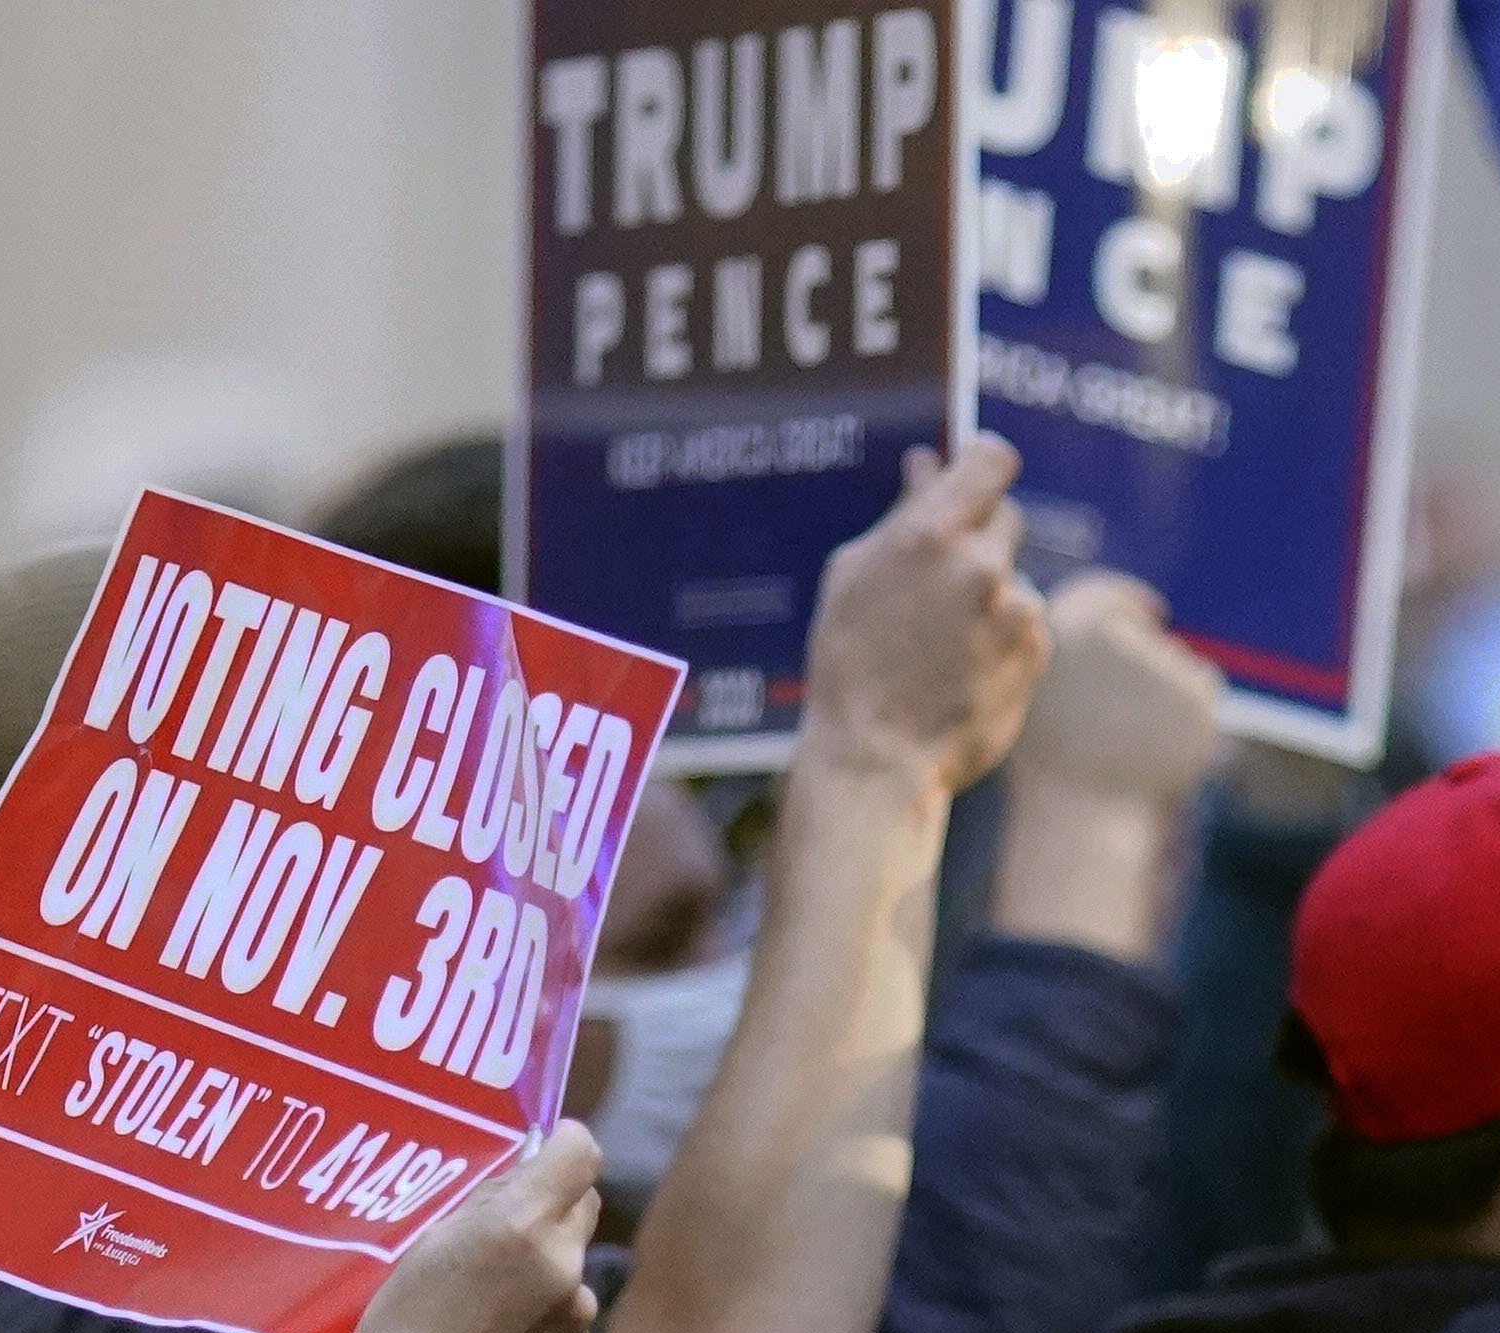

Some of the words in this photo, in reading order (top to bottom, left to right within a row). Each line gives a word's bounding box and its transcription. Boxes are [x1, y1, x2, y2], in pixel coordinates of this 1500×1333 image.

[539, 5, 940, 238] TRUMP
[570, 238, 904, 387] PENCE
[85, 557, 389, 806] VOTING
[370, 652, 632, 900] CLOSED
[39, 757, 200, 952] ON
[158, 798, 384, 1028] NOV.
[375, 877, 549, 1092] 3RD
[242, 1096, 326, 1190] TO
[299, 1121, 468, 1223] 41490
